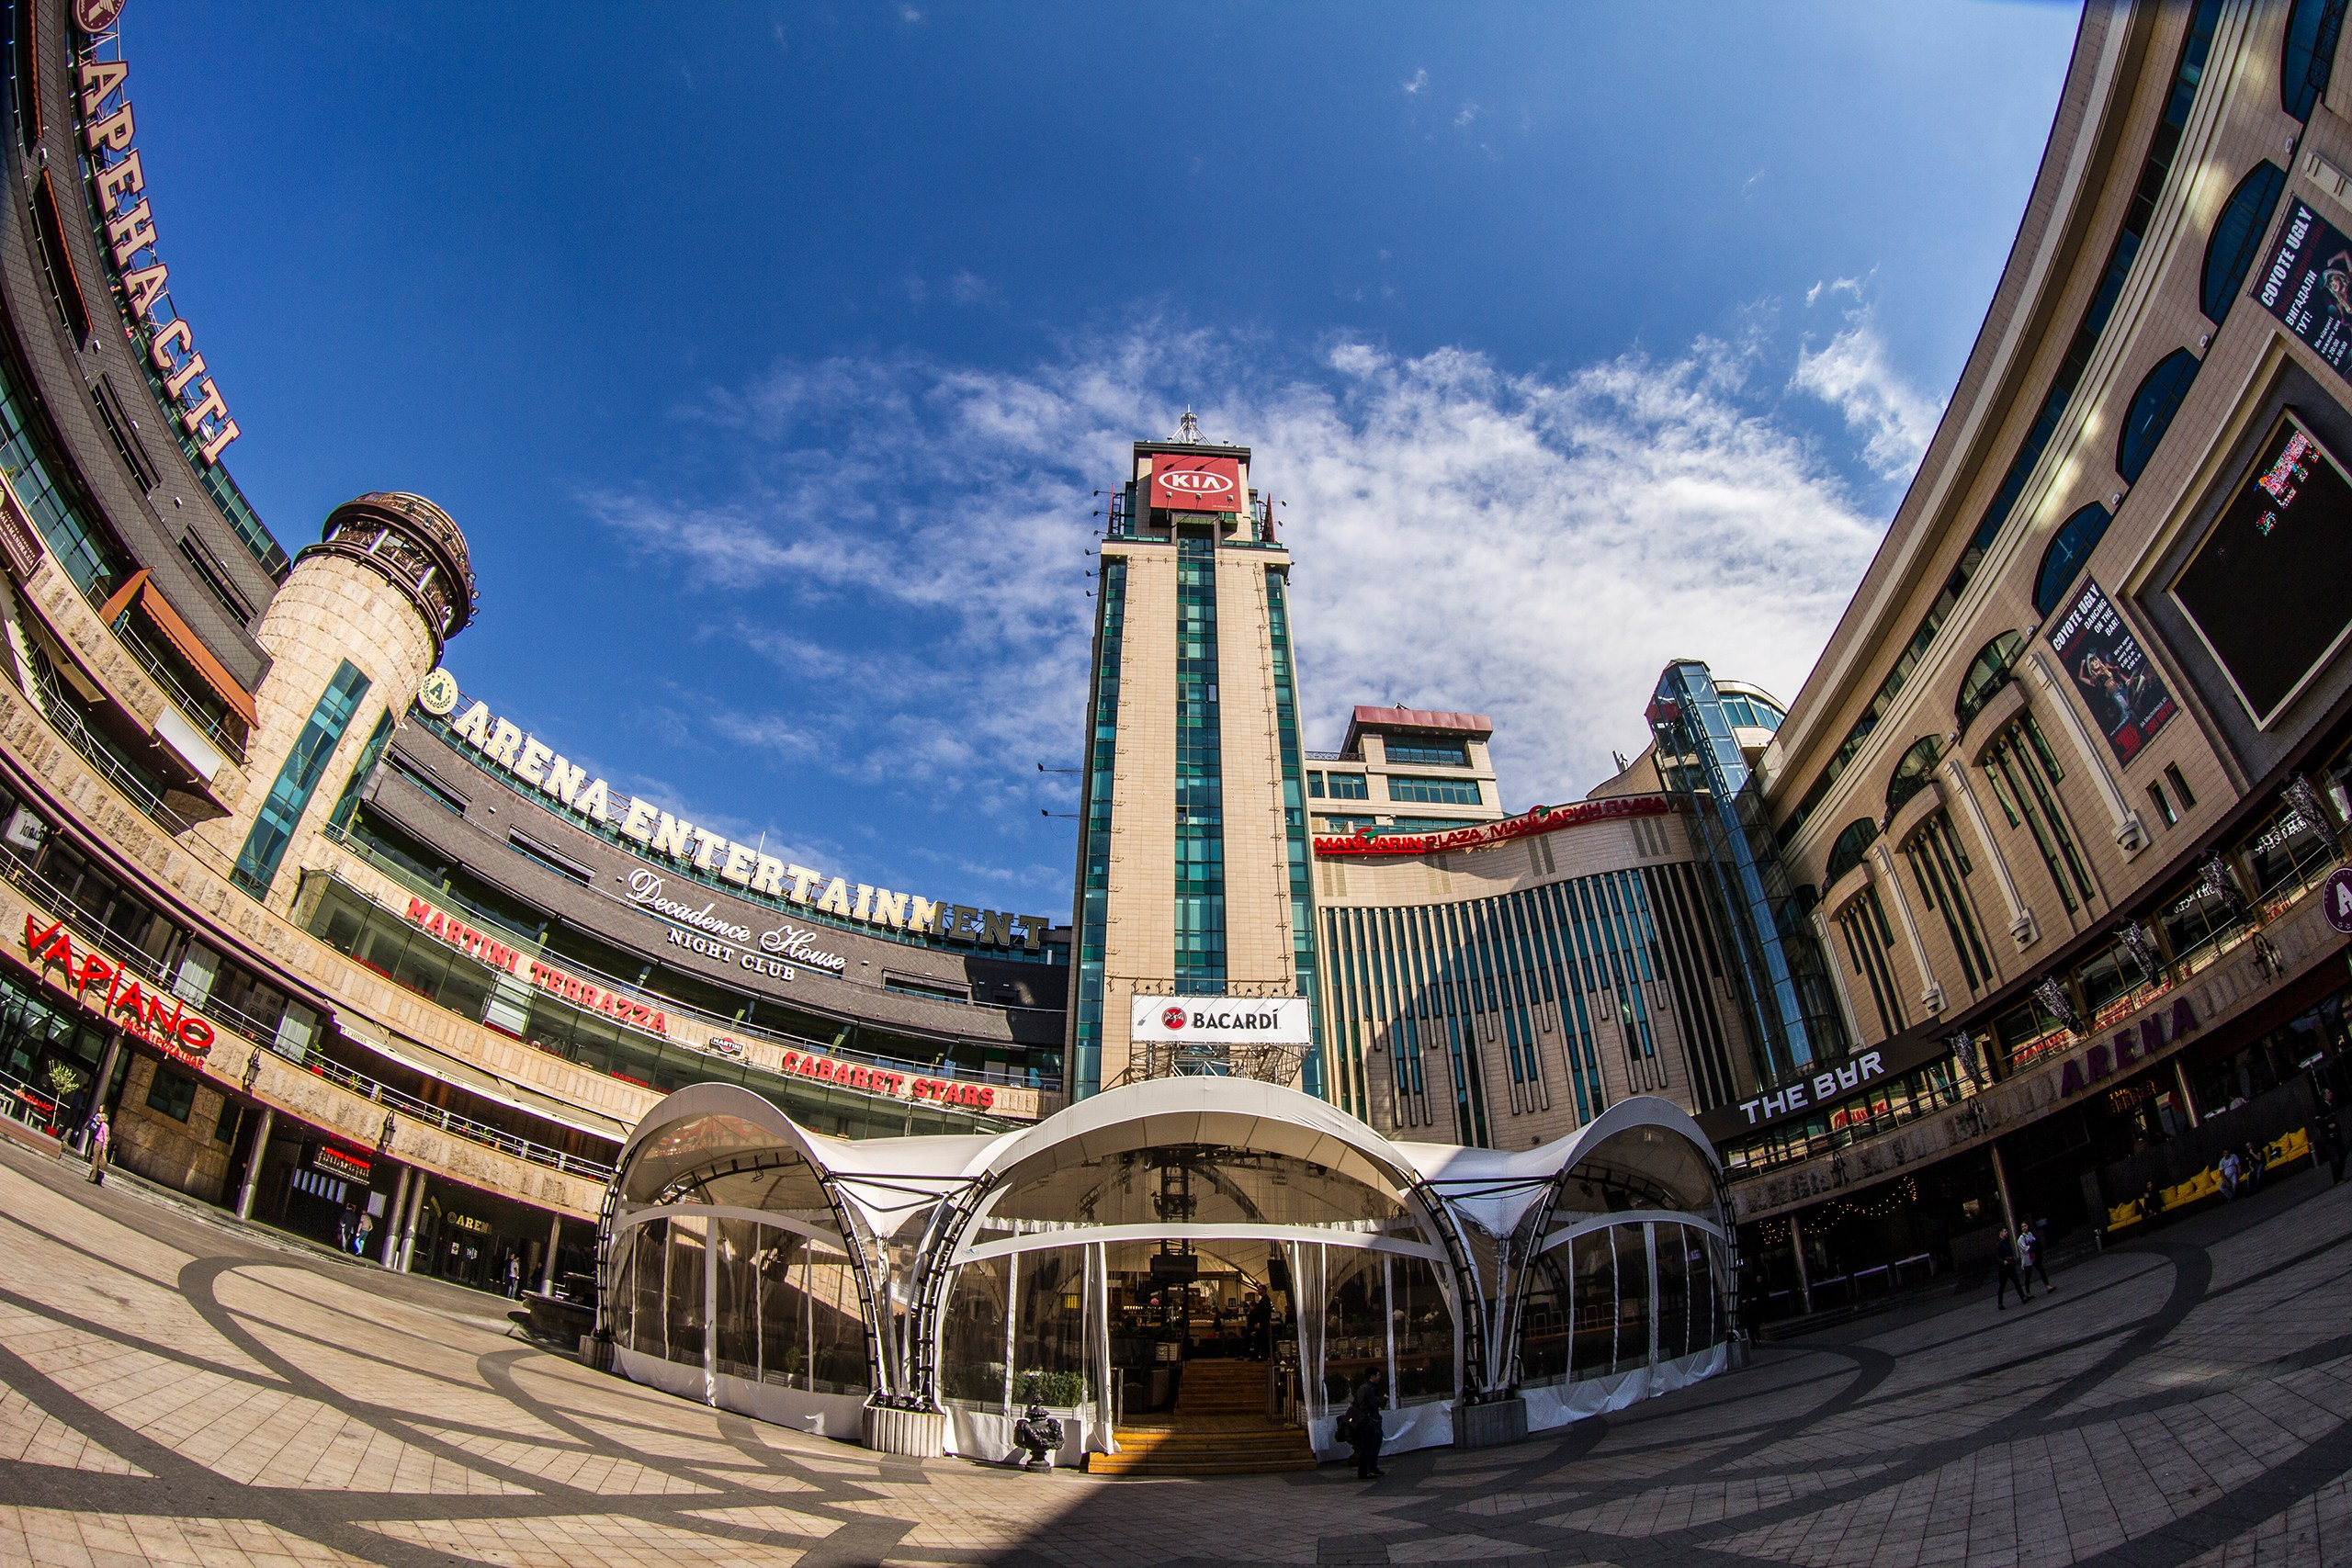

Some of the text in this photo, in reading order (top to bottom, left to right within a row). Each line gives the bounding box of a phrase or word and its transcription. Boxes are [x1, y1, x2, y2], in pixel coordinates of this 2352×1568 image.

[2261, 247, 2296, 308] COYOTE
[2286, 206, 2312, 251] UGLY
[2285, 270, 2317, 326] ВИГАДАЛИ
[2296, 310, 2312, 334] ТУТ!
[1171, 475, 1221, 490] KIA
[2052, 610, 2083, 651] COYOTE
[2077, 584, 2101, 615] UGLY
[2084, 598, 2108, 630] DANCING
[2094, 607, 2114, 634] ON THE
[2105, 617, 2120, 637] BAR!
[454, 701, 1049, 951] ARENA ENTERTAINMENT
[1488, 805, 1603, 839] МАНДАРИН
[1604, 796, 1668, 814] ПЛАЗА
[1315, 828, 1484, 851] MANDARIN PLAZA
[626, 867, 845, 971] Decadence House
[353, 953, 392, 979] MARTINI
[406, 896, 667, 1034] MARTINI TERRAZZA
[668, 928, 797, 982] NIGHT CLUB
[1193, 1008, 1279, 1030] BACARDÍ
[121, 1017, 204, 1069] PASTA PIZZA BAR
[711, 1037, 742, 1054] MARTINI
[2061, 997, 2197, 1098] ARENA
[611, 1071, 650, 1088] MARTINI
[782, 1051, 994, 1110] CABARET STARS
[1739, 1083, 1809, 1124] THE
